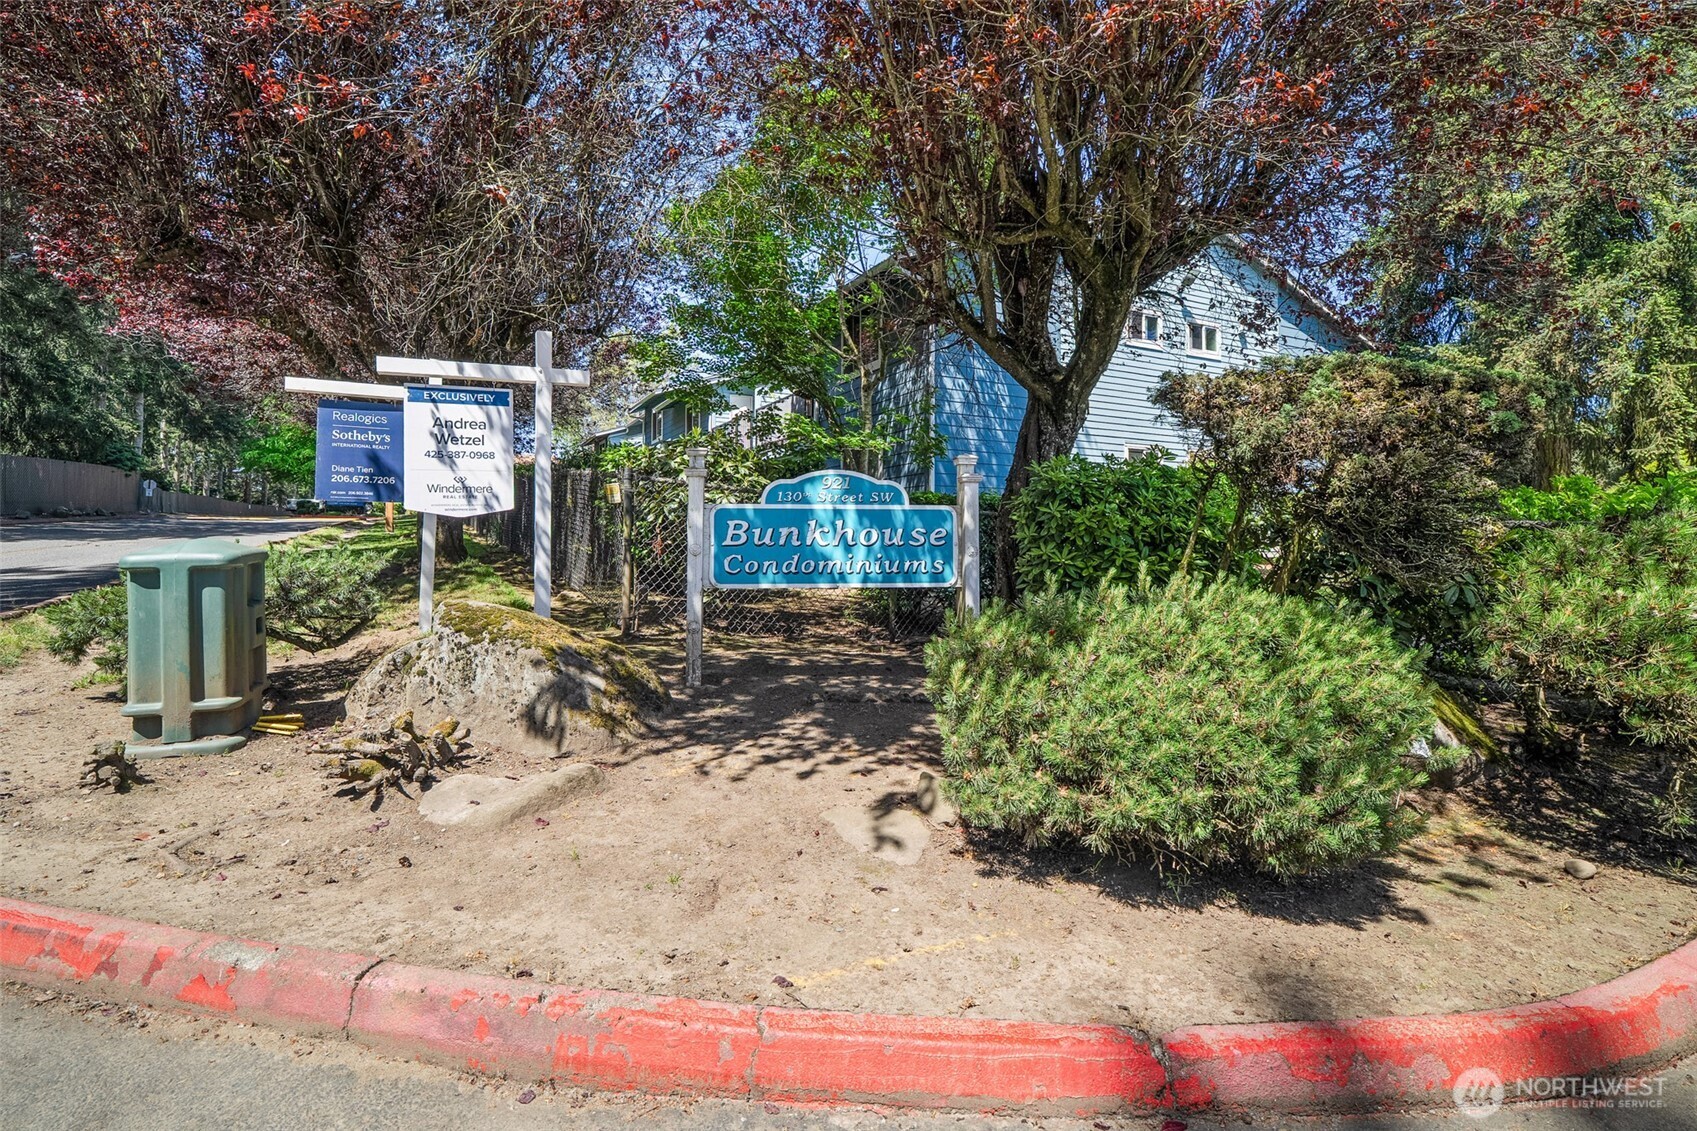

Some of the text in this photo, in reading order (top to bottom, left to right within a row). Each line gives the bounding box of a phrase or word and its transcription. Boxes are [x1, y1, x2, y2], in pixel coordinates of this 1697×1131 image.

[423, 391, 495, 402] EXCLUSIVELY
[332, 410, 388, 425] Realogics
[432, 416, 487, 430] Andrea
[331, 429, 391, 444] Sotheby's
[434, 433, 485, 446] Wetzel
[331, 442, 372, 450] INTERNATIONAL
[424, 450, 496, 460] 425-387-0968
[331, 464, 374, 474] Diane Tien
[331, 474, 396, 485] 206.673.7206
[821, 476, 851, 490] 921
[426, 483, 494, 494] Windermere
[816, 491, 864, 503] Street
[869, 491, 894, 503] SW
[721, 519, 948, 548] Bunkhouse
[723, 552, 945, 575] Condominiums
